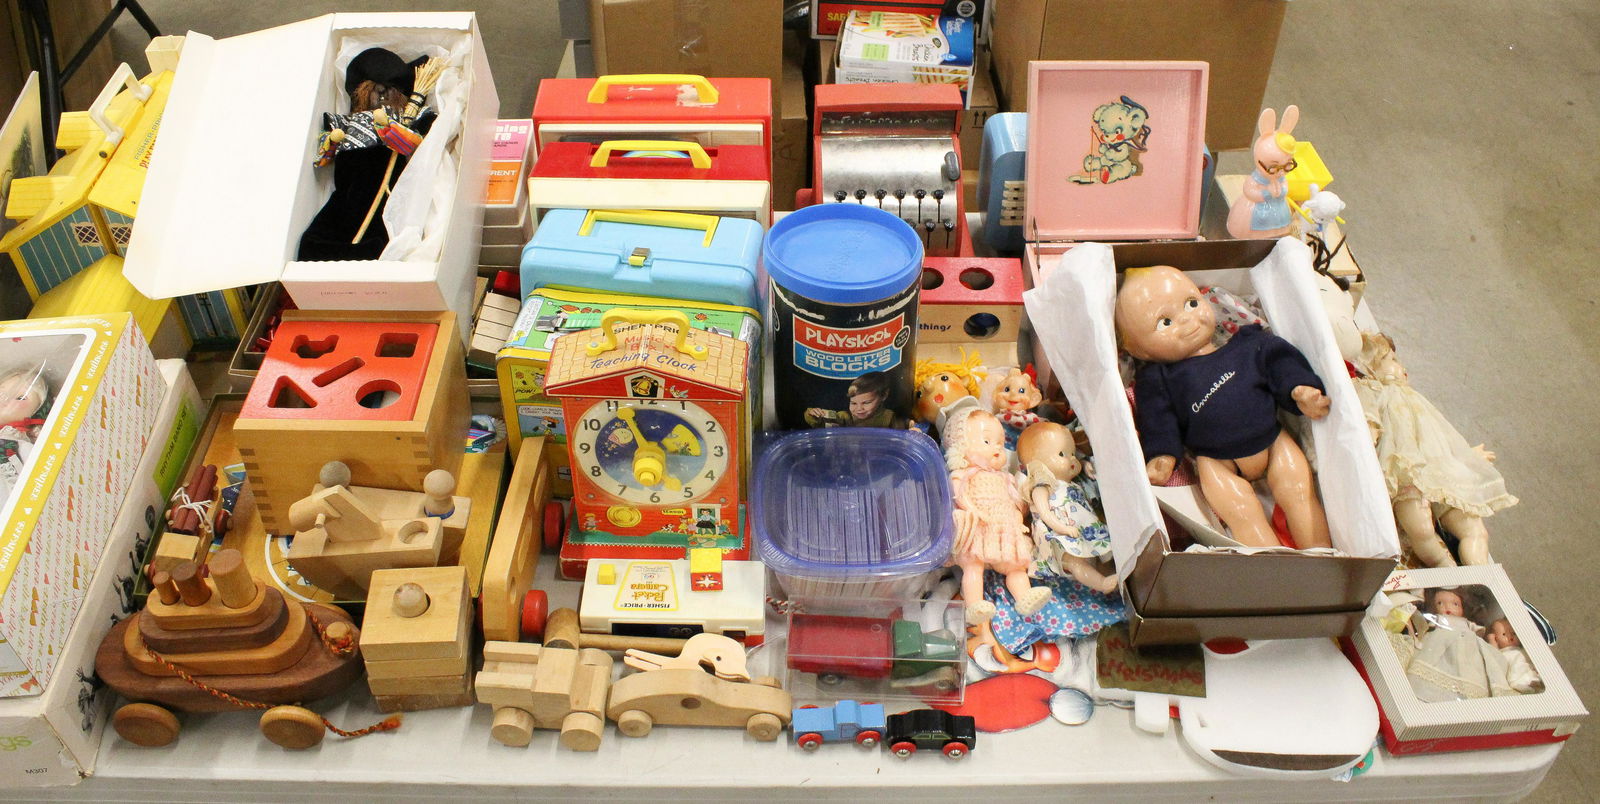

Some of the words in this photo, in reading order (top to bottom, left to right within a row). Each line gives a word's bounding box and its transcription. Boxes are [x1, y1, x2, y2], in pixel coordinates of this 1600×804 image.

[805, 326, 891, 348] PLAYSKOOL
[590, 351, 650, 370] Teaching
[656, 354, 697, 372] Clock
[805, 348, 845, 362] WOOD
[847, 347, 891, 362] LETTER
[805, 355, 891, 372] BLOCKS
[583, 418, 601, 431] 10
[705, 420, 716, 432] 2
[579, 442, 591, 454] 9
[714, 445, 724, 457] 3
[590, 465, 602, 477] 8
[704, 469, 715, 481] 4
[618, 484, 628, 496] 7
[683, 487, 694, 498] 5
[649, 492, 661, 503] 6
[631, 583, 667, 591] Camera
[632, 591, 664, 601] Pocket
